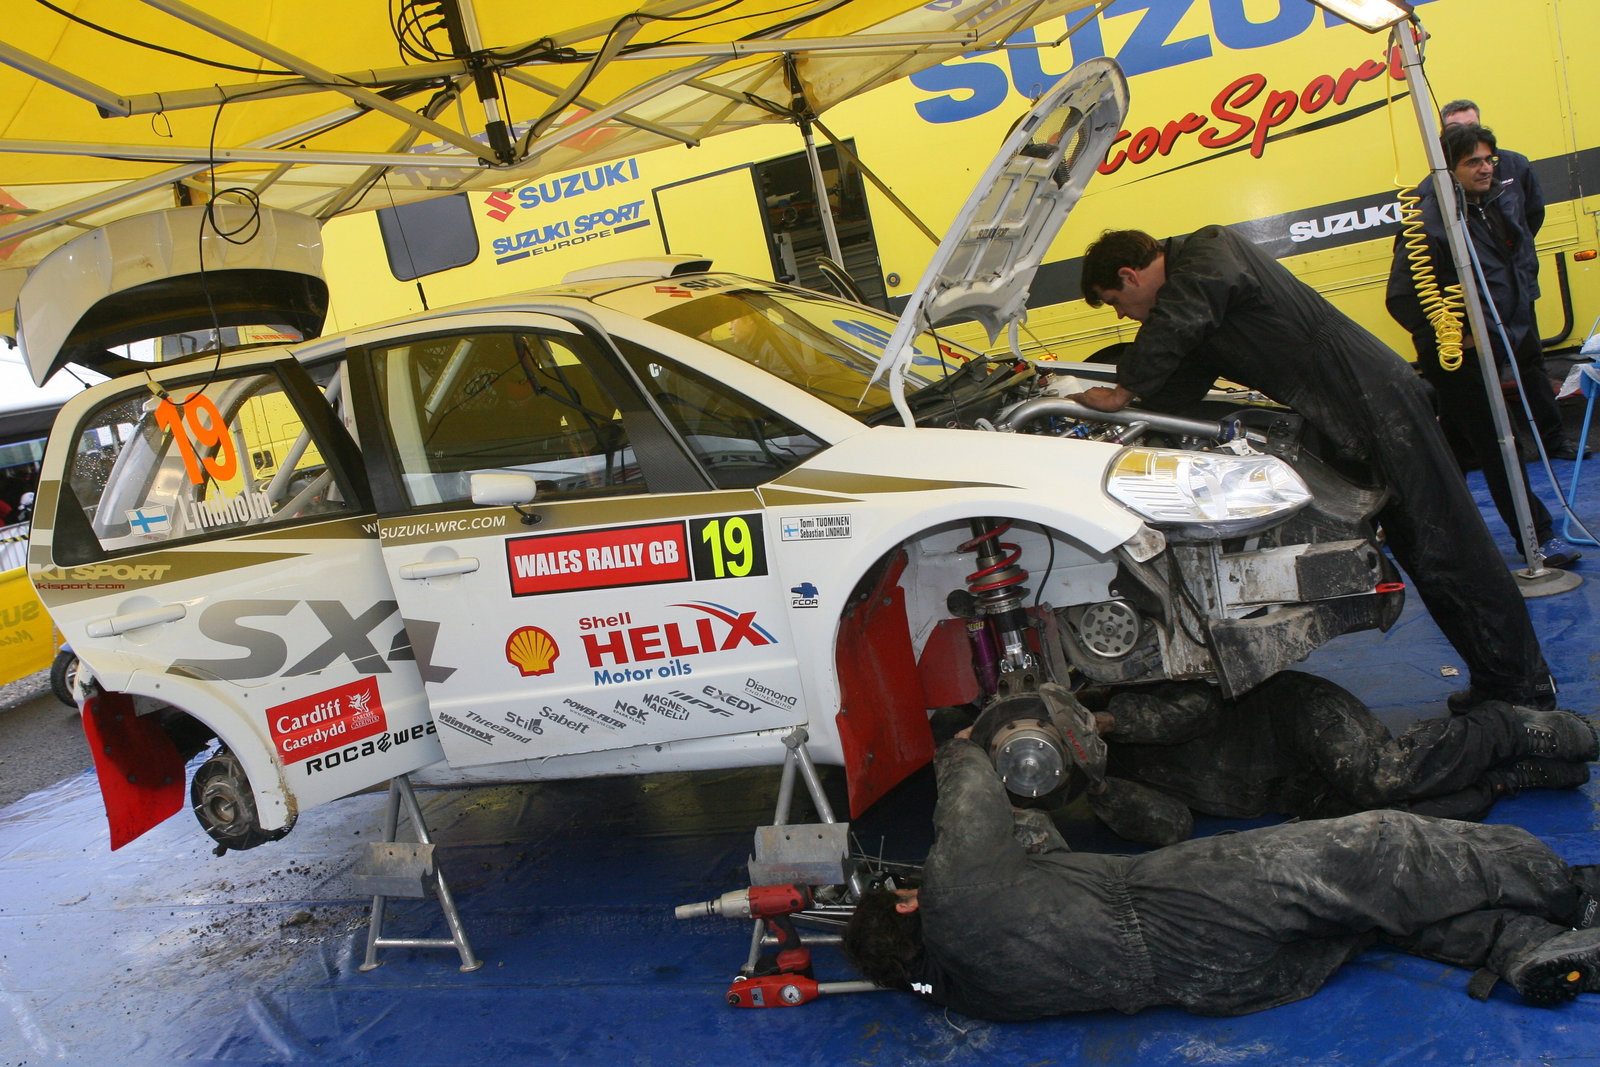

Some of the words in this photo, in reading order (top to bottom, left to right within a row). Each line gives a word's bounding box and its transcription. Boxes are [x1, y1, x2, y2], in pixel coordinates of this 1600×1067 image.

[908, 0, 1440, 124] SUZU
[518, 158, 640, 210] SUZUKI
[492, 220, 569, 256] SUZUKI
[573, 200, 645, 235] SPORT
[1289, 201, 1405, 243] SUZUKI
[532, 229, 611, 256] EUROPE
[154, 392, 237, 485] 19
[178, 489, 274, 530] Lindholm
[800, 518, 815, 528] Tomi
[816, 516, 850, 527] TUOMINEN
[362, 521, 380, 534] W
[380, 515, 506, 539] SUZUKI-WRC.COM
[800, 528, 825, 539] Sebastian
[825, 527, 850, 537] LINDHOLM
[514, 548, 583, 578] WALES
[585, 543, 644, 571] RALLY
[648, 540, 679, 565] GB
[702, 516, 754, 578] 19
[35, 583, 125, 591] kisport.com
[71, 564, 171, 581] SPORT
[579, 611, 632, 630] Shell
[580, 606, 772, 668] HELIX
[594, 666, 653, 687] Motor
[658, 659, 692, 678] oils
[562, 698, 598, 716] POWER
[596, 713, 627, 729] FILTER
[614, 699, 650, 722] NGK
[702, 685, 762, 714] EXEDY
[276, 698, 341, 734] Cardiff
[438, 711, 496, 743] Winmax
[465, 710, 532, 744] ThreeBond
[504, 711, 544, 735] Stilo
[539, 706, 590, 735] Sabelt
[282, 721, 346, 752] Caerdydd
